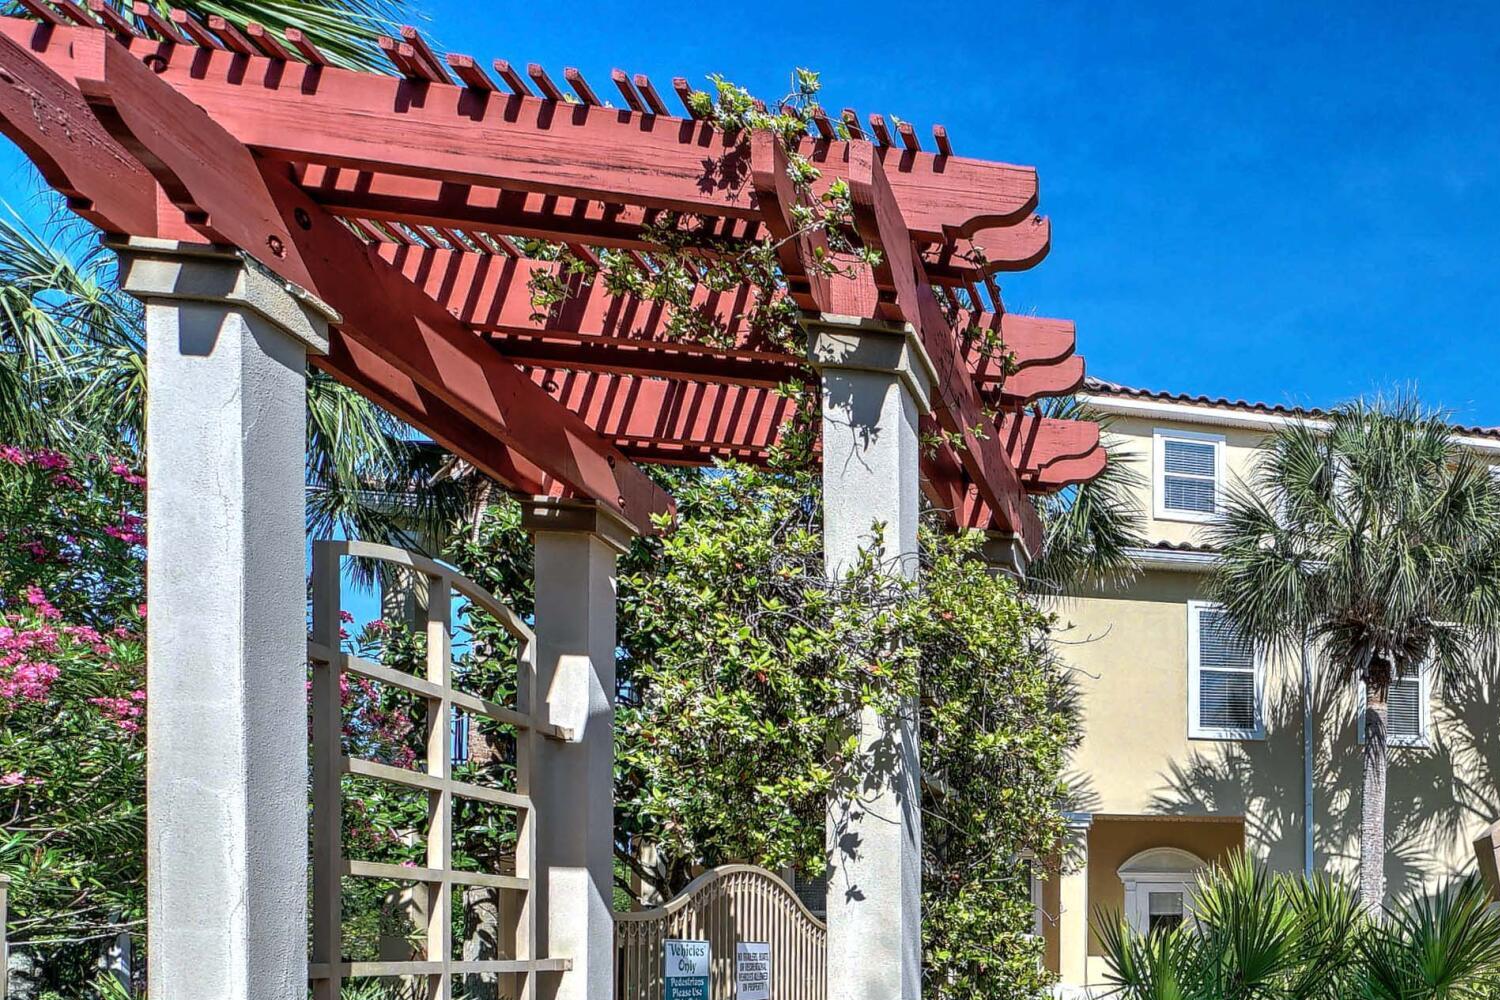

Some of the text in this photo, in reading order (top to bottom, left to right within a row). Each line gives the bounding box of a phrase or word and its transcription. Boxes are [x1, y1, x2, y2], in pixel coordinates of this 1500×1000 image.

[678, 959, 697, 974] Only
[672, 987, 703, 998] Please Use
